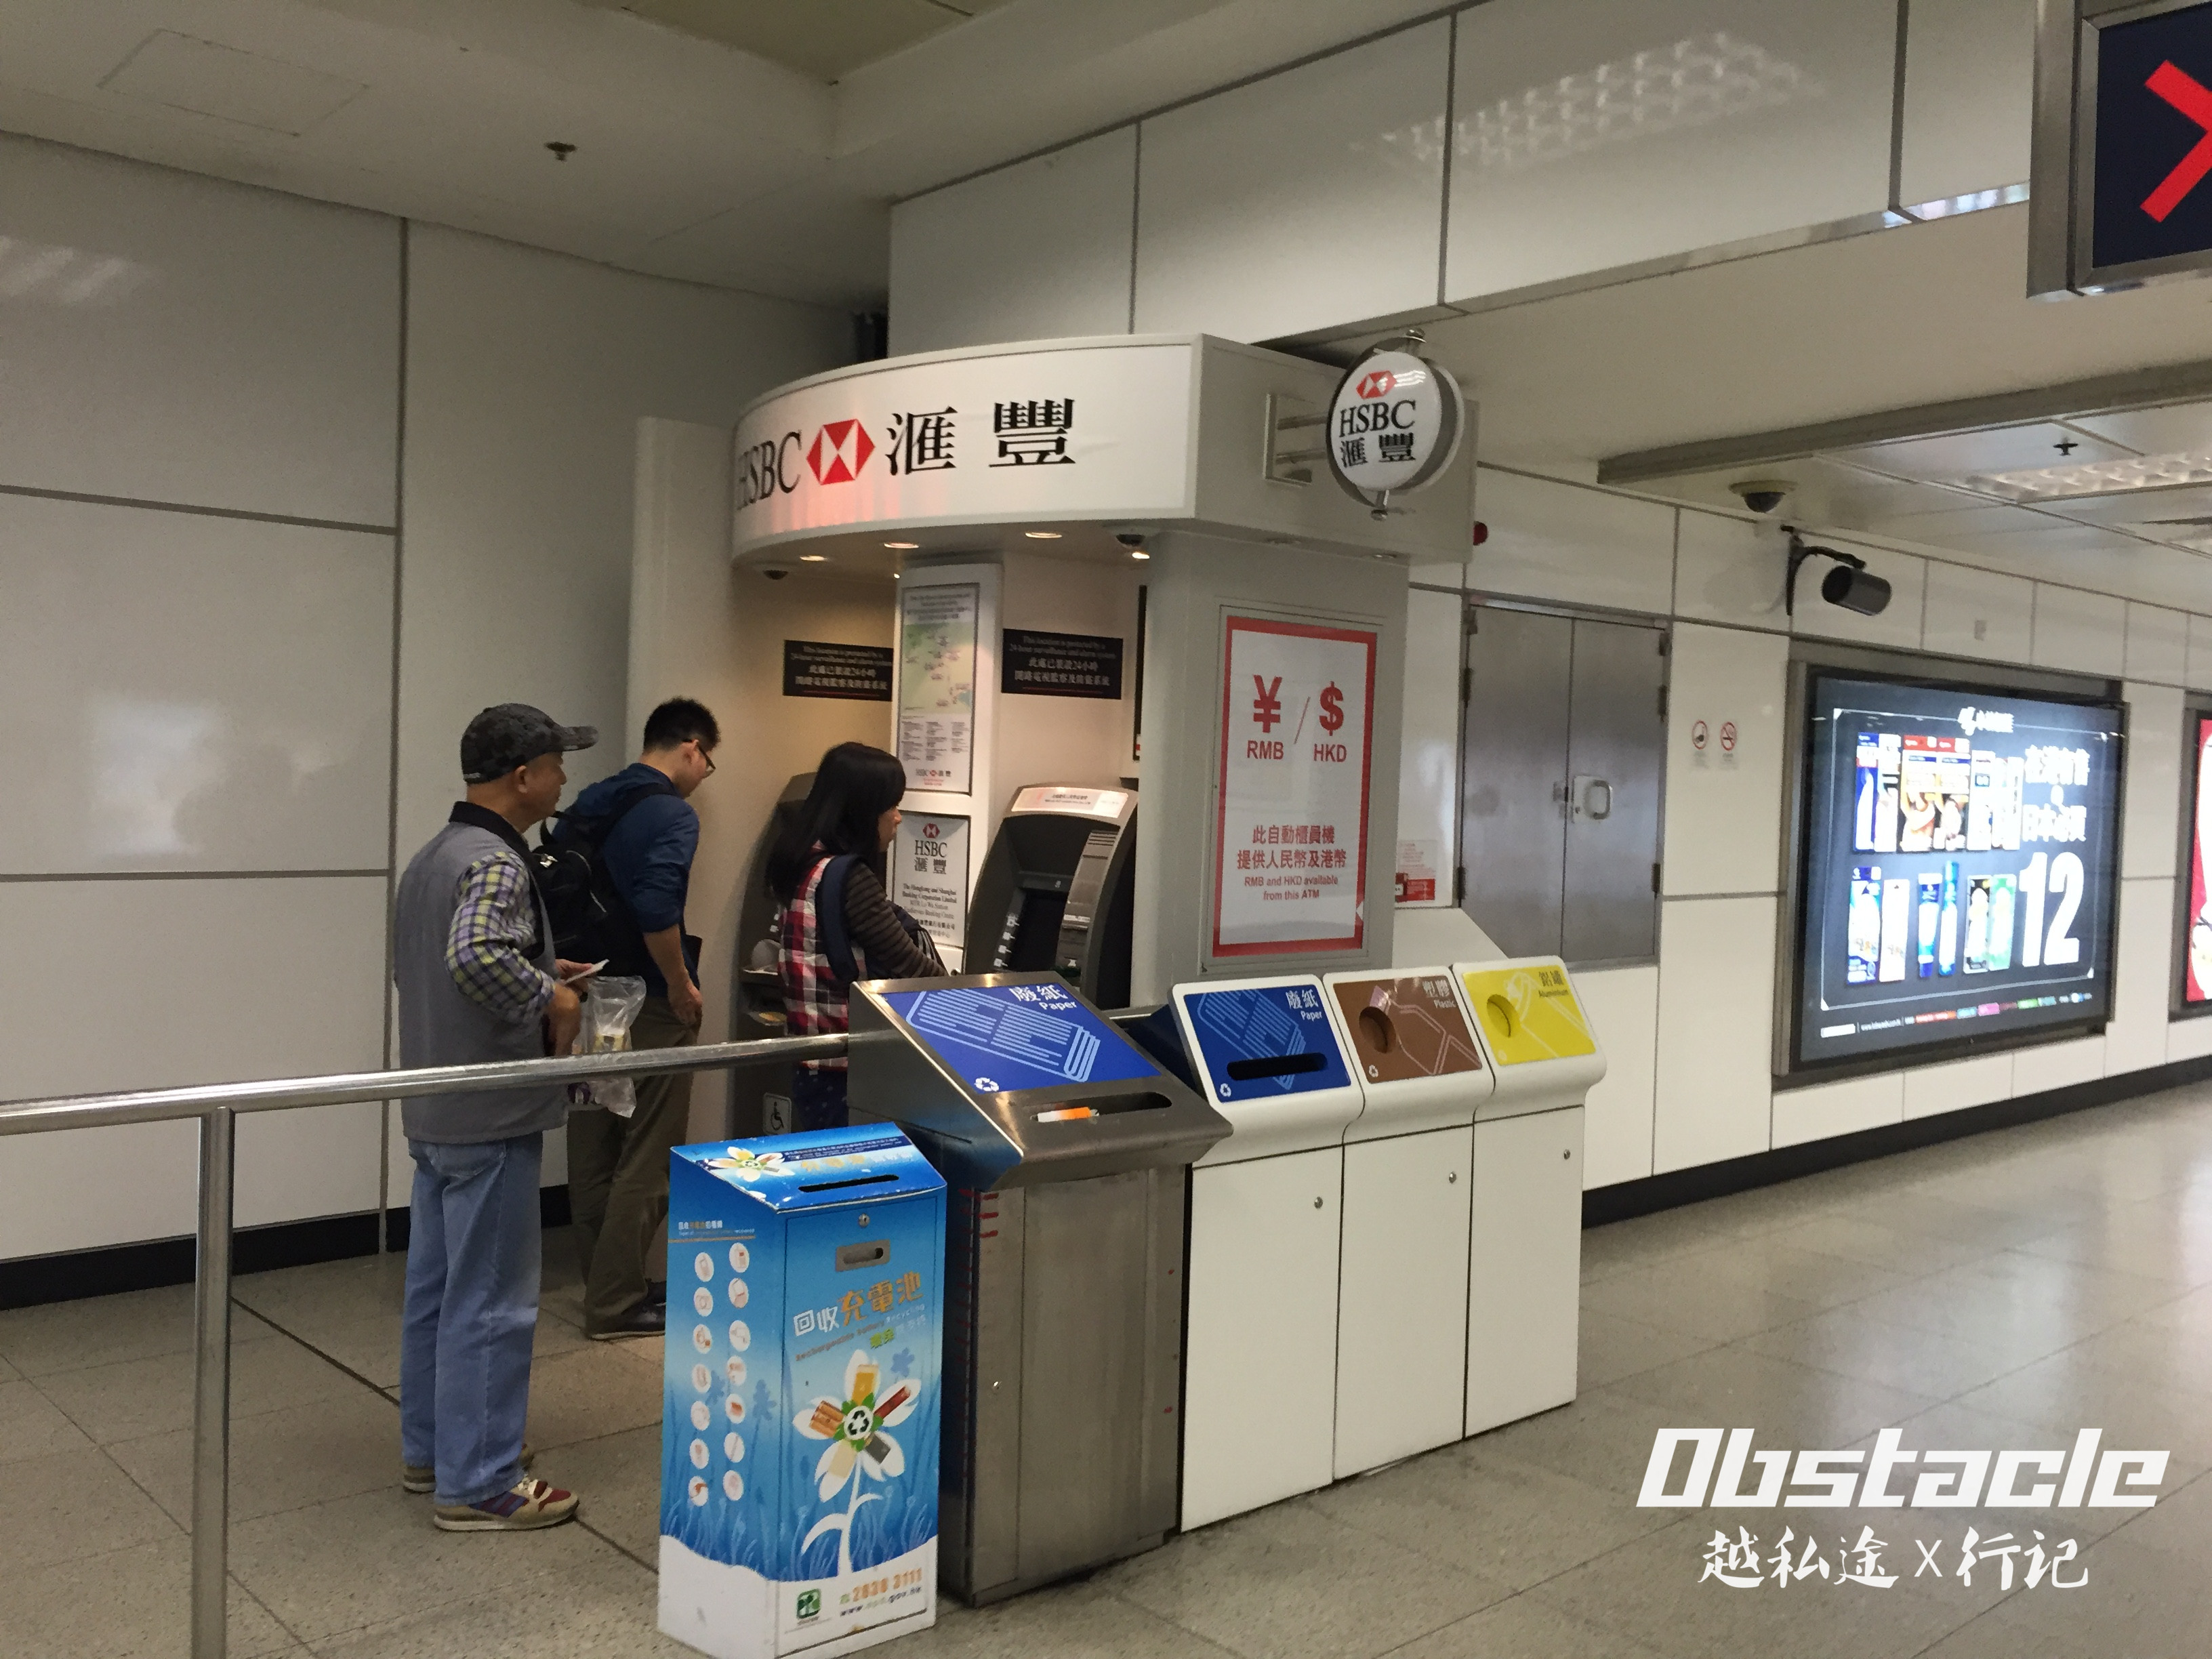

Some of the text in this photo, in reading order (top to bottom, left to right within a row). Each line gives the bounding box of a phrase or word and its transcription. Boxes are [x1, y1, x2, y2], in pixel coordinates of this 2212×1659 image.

[1339, 399, 1416, 438] HSBC
[737, 398, 1076, 511] HSBC 滙豐
[1319, 681, 1344, 736] $
[1247, 740, 1347, 762] RMB HKD
[1252, 824, 1335, 844] 此自動櫃員機
[914, 840, 947, 858] HSBC
[1237, 848, 1347, 869] 提供人民幣及港幣
[1244, 874, 1338, 886] RMB and HKD available
[1263, 889, 1319, 901] from this ATM
[2019, 851, 2085, 967] 12
[1008, 984, 1068, 1002] 廢紙
[1286, 989, 1319, 1009] 廢紙
[1038, 1001, 1077, 1011] Paper
[1433, 1000, 1456, 1008] Plastic
[1300, 1010, 1323, 1022] Paper
[793, 1271, 923, 1336] 回收充電池
